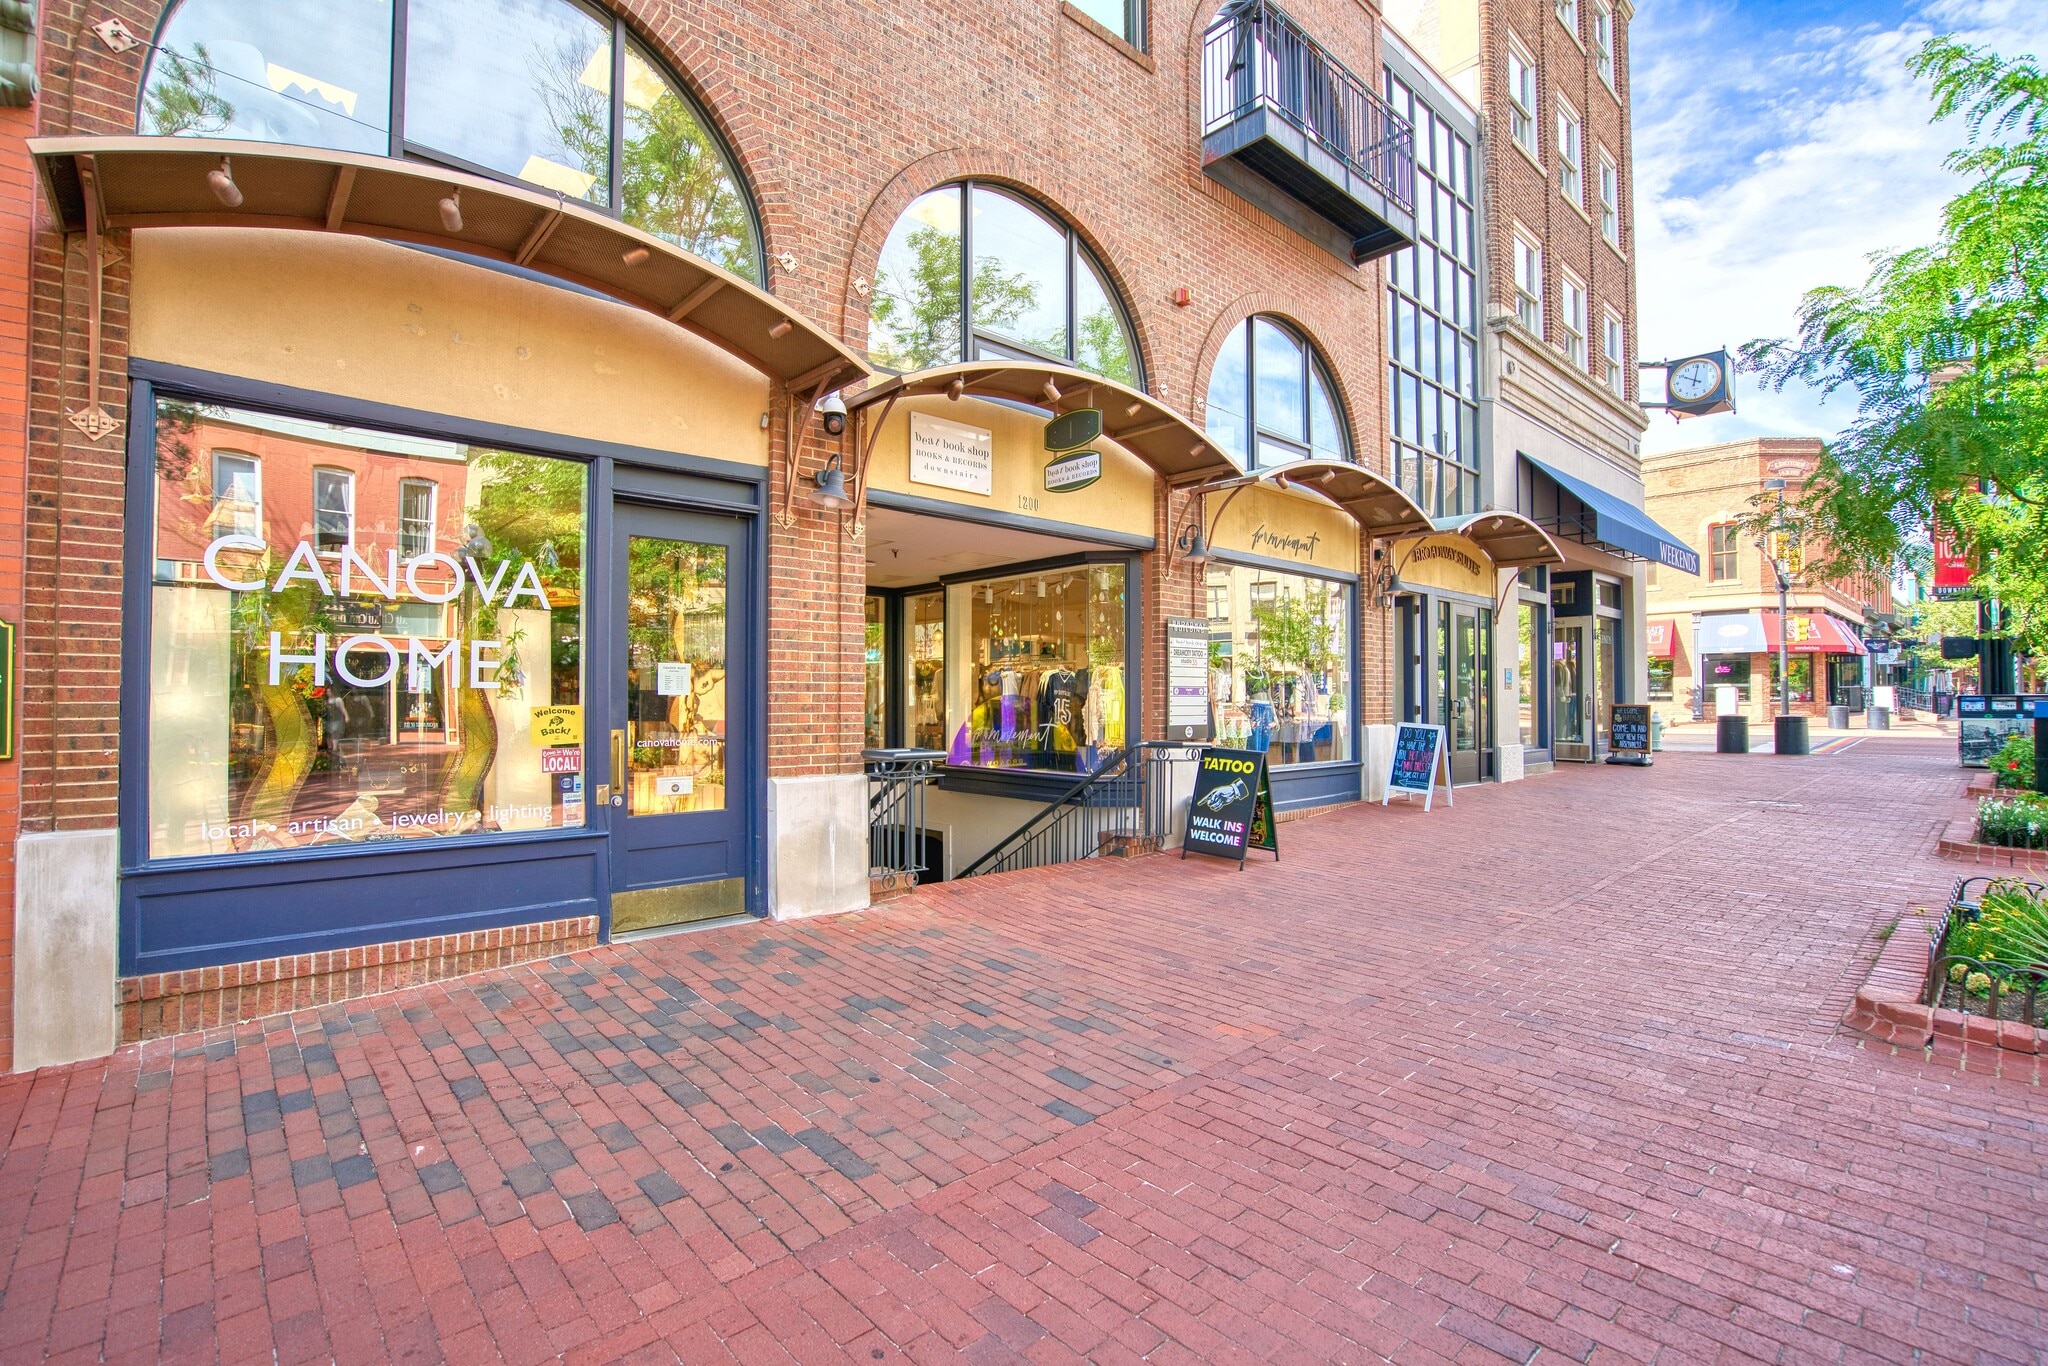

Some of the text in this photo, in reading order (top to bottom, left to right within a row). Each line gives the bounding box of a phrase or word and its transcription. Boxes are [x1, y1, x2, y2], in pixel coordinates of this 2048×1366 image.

[914, 432, 990, 460] beat book shop
[915, 449, 988, 470] BOOKS & RECORDS
[1047, 458, 1098, 477] beat book shop
[924, 463, 979, 480] downstairs
[1047, 476, 1065, 486] BOOKS
[1071, 469, 1098, 480] RECORDS
[1018, 494, 1040, 511] 1200
[1413, 546, 1481, 576] BROADWAY SUITES
[1659, 542, 1697, 573] WEEKENDS
[203, 534, 551, 610] CANOVA
[268, 631, 502, 689] HOME
[534, 707, 576, 718] Welcome
[1053, 697, 1072, 725] 15
[540, 727, 571, 736] Back!
[1404, 728, 1427, 740] DO YOU
[1612, 724, 1628, 732] COME
[1637, 725, 1647, 733] AND
[636, 738, 718, 748] canovahome.com
[562, 748, 580, 756] We're
[543, 756, 579, 772] LOCAL!
[1204, 757, 1255, 774] TATTOO
[201, 818, 258, 840] local
[288, 810, 364, 835] artisan
[391, 807, 465, 831] jewelry
[490, 800, 553, 823] lighting
[1192, 816, 1244, 833] WALK INS
[1190, 829, 1242, 847] WELCOME
